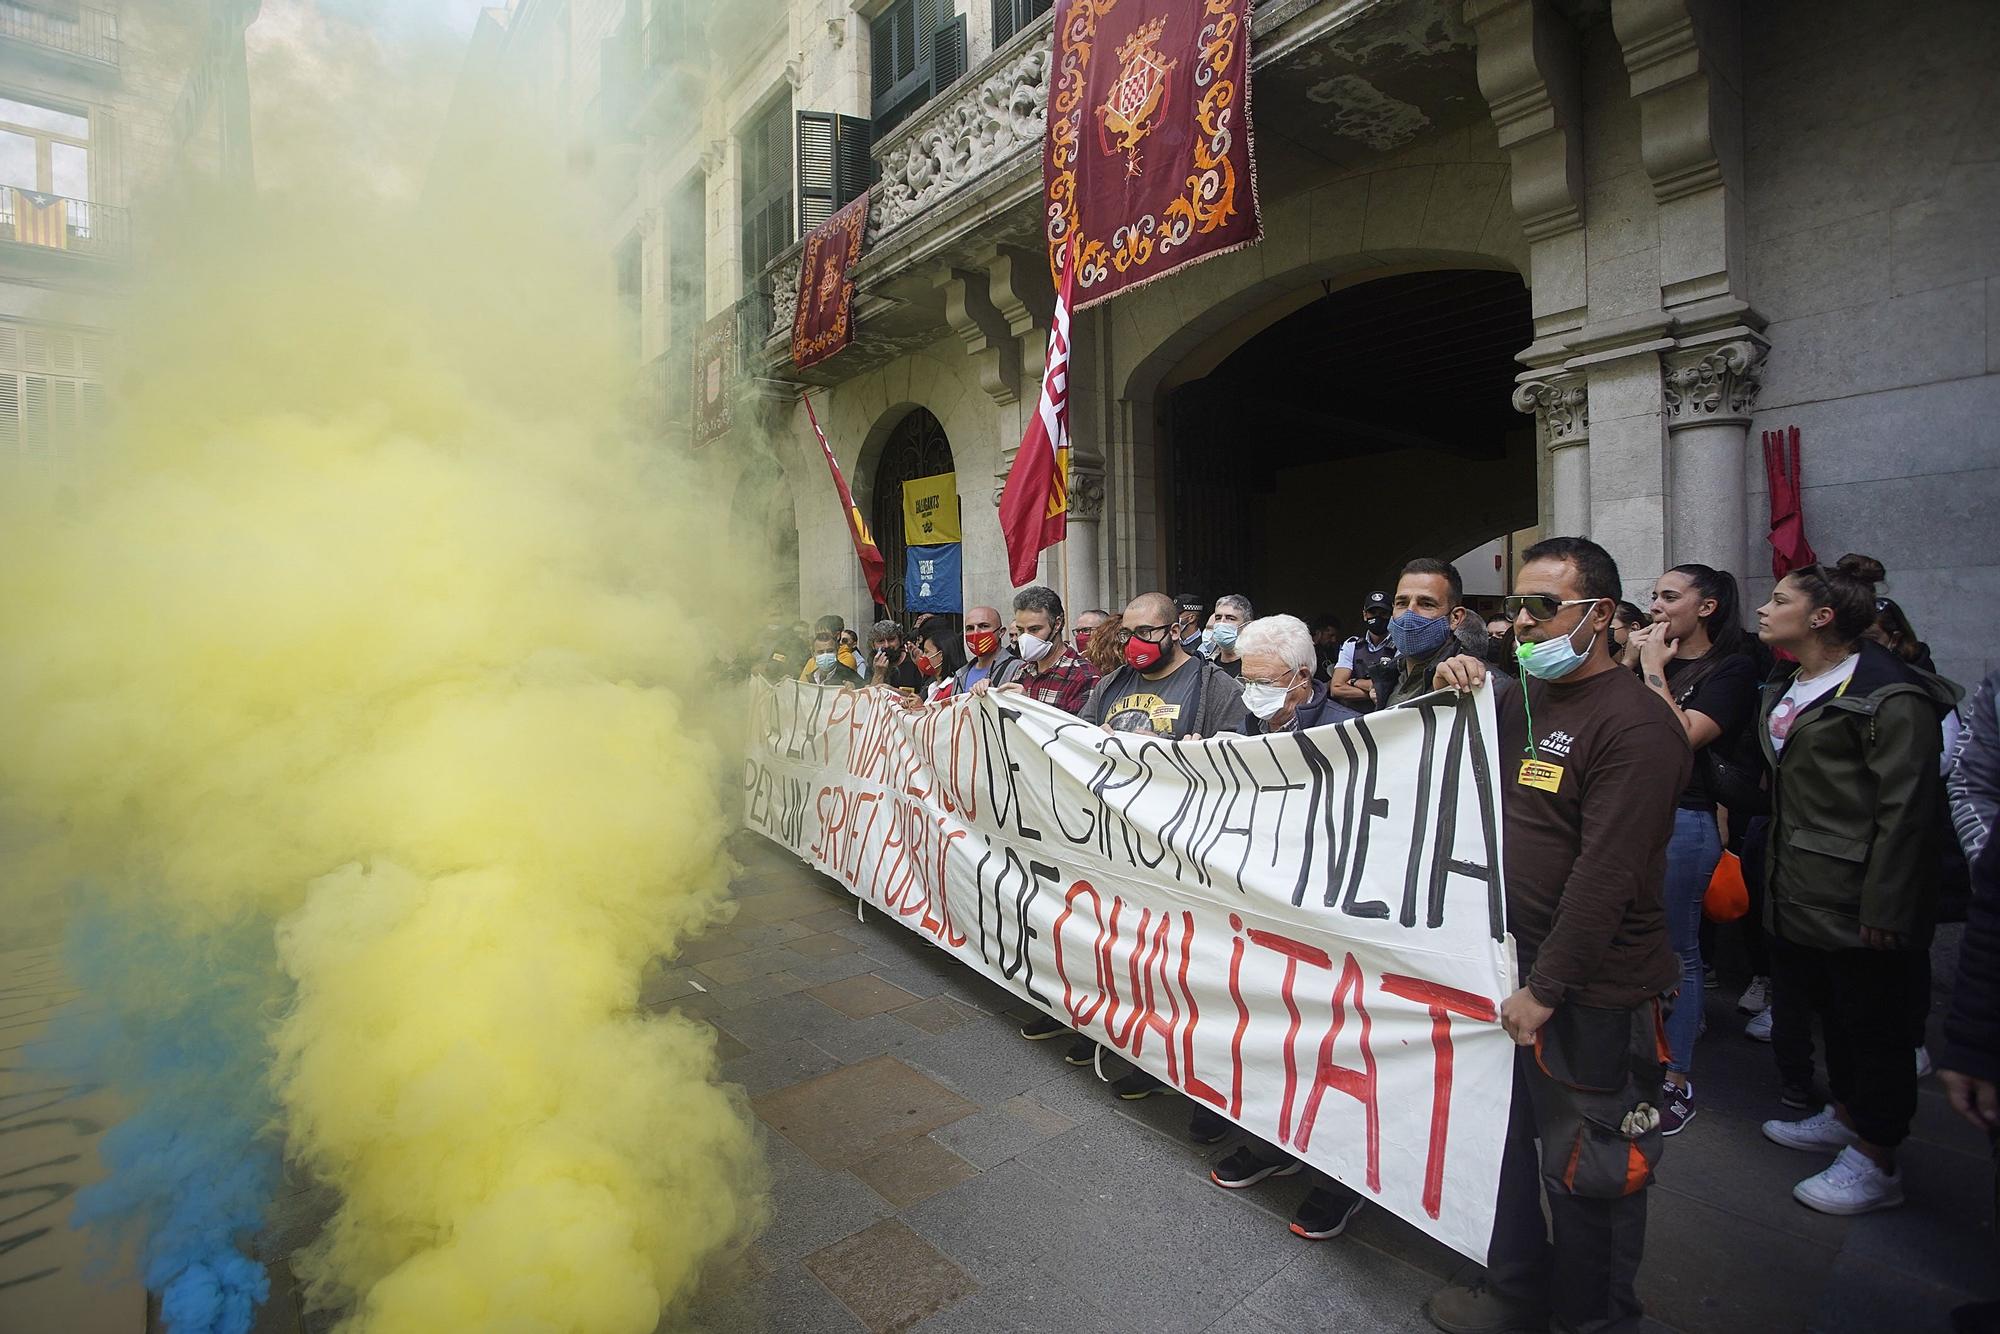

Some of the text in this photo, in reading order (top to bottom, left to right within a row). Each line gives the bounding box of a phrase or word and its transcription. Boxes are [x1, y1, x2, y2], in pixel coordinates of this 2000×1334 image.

[980, 700, 1042, 842] DE
[744, 758, 774, 834] PER
[780, 774, 812, 849] UN
[994, 846, 1061, 1009] DE
